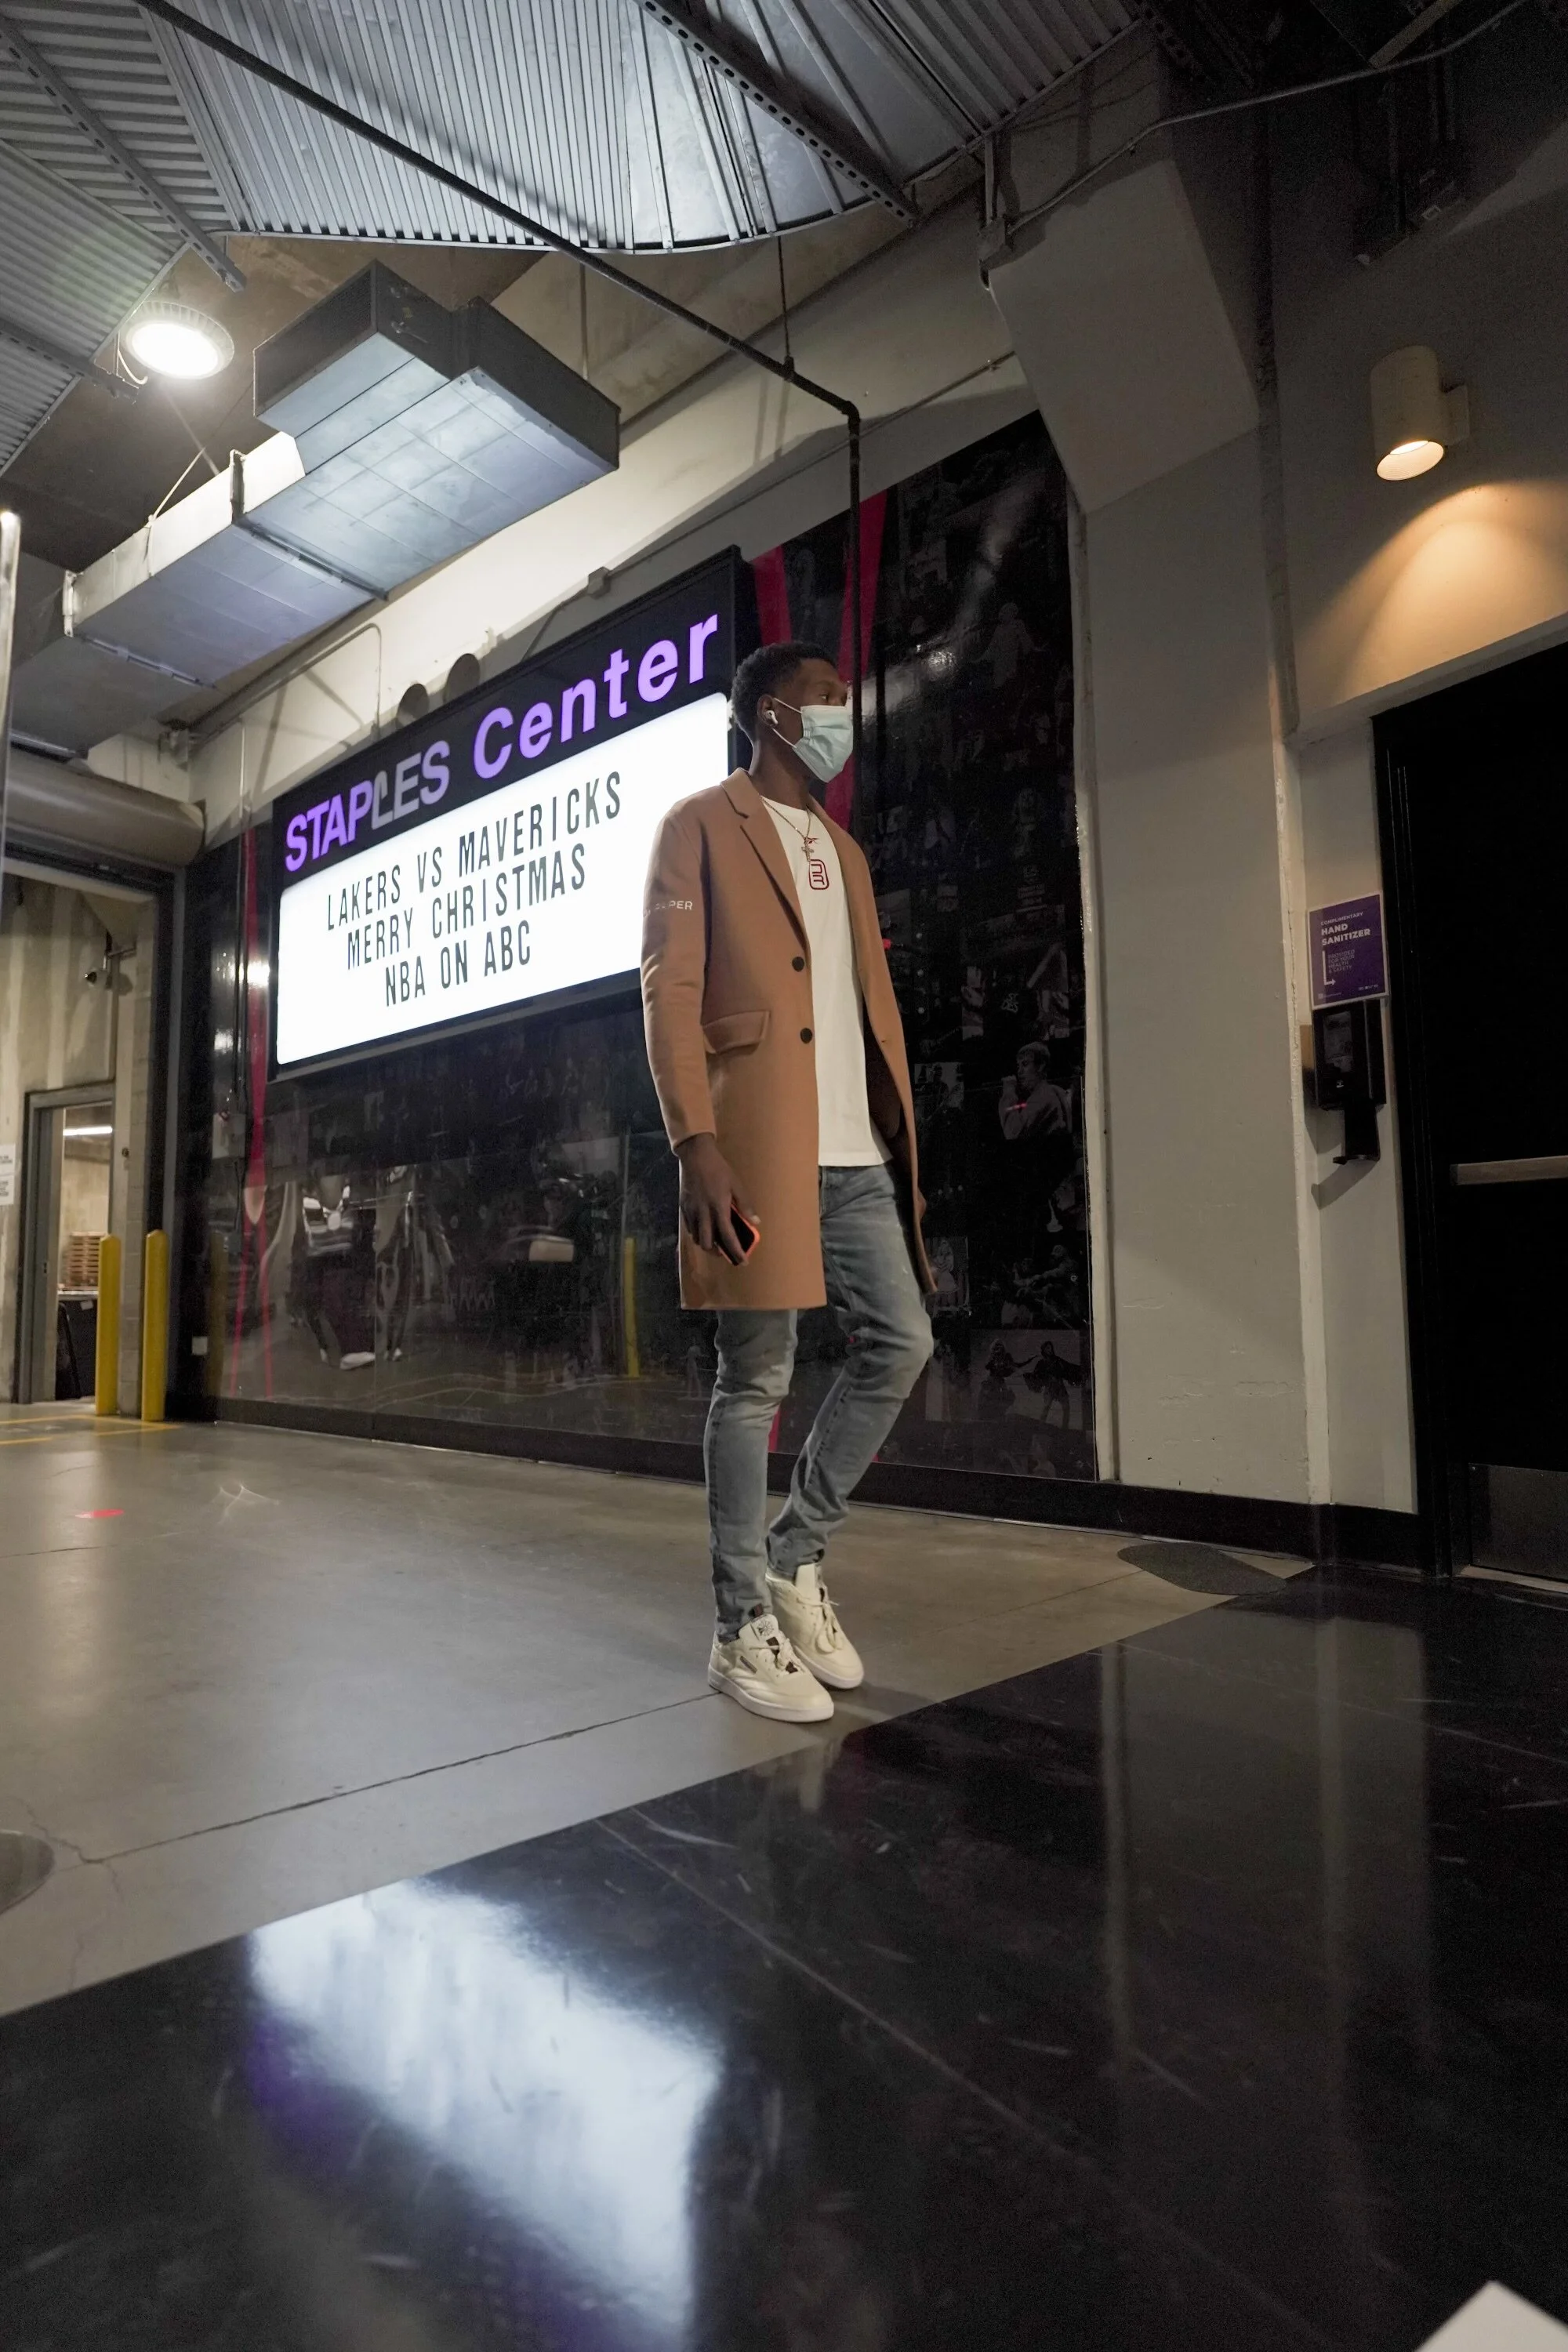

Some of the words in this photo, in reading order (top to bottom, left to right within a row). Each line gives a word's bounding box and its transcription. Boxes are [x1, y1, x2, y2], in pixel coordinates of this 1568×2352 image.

[285, 740, 450, 872] STAPLES
[474, 614, 718, 779] Center
[327, 866, 401, 931] LAKERS
[416, 846, 442, 893] VS
[459, 771, 622, 877] MAVERICKS
[347, 909, 413, 970] MERRY
[432, 843, 586, 939] CHRISTMAS
[1320, 912, 1364, 926] COMPLIMENTARY
[1321, 923, 1348, 936] HAND
[1322, 928, 1371, 946] SANITIZER
[385, 956, 426, 1007] NBA
[440, 940, 467, 989] ON
[484, 920, 532, 978] ABC
